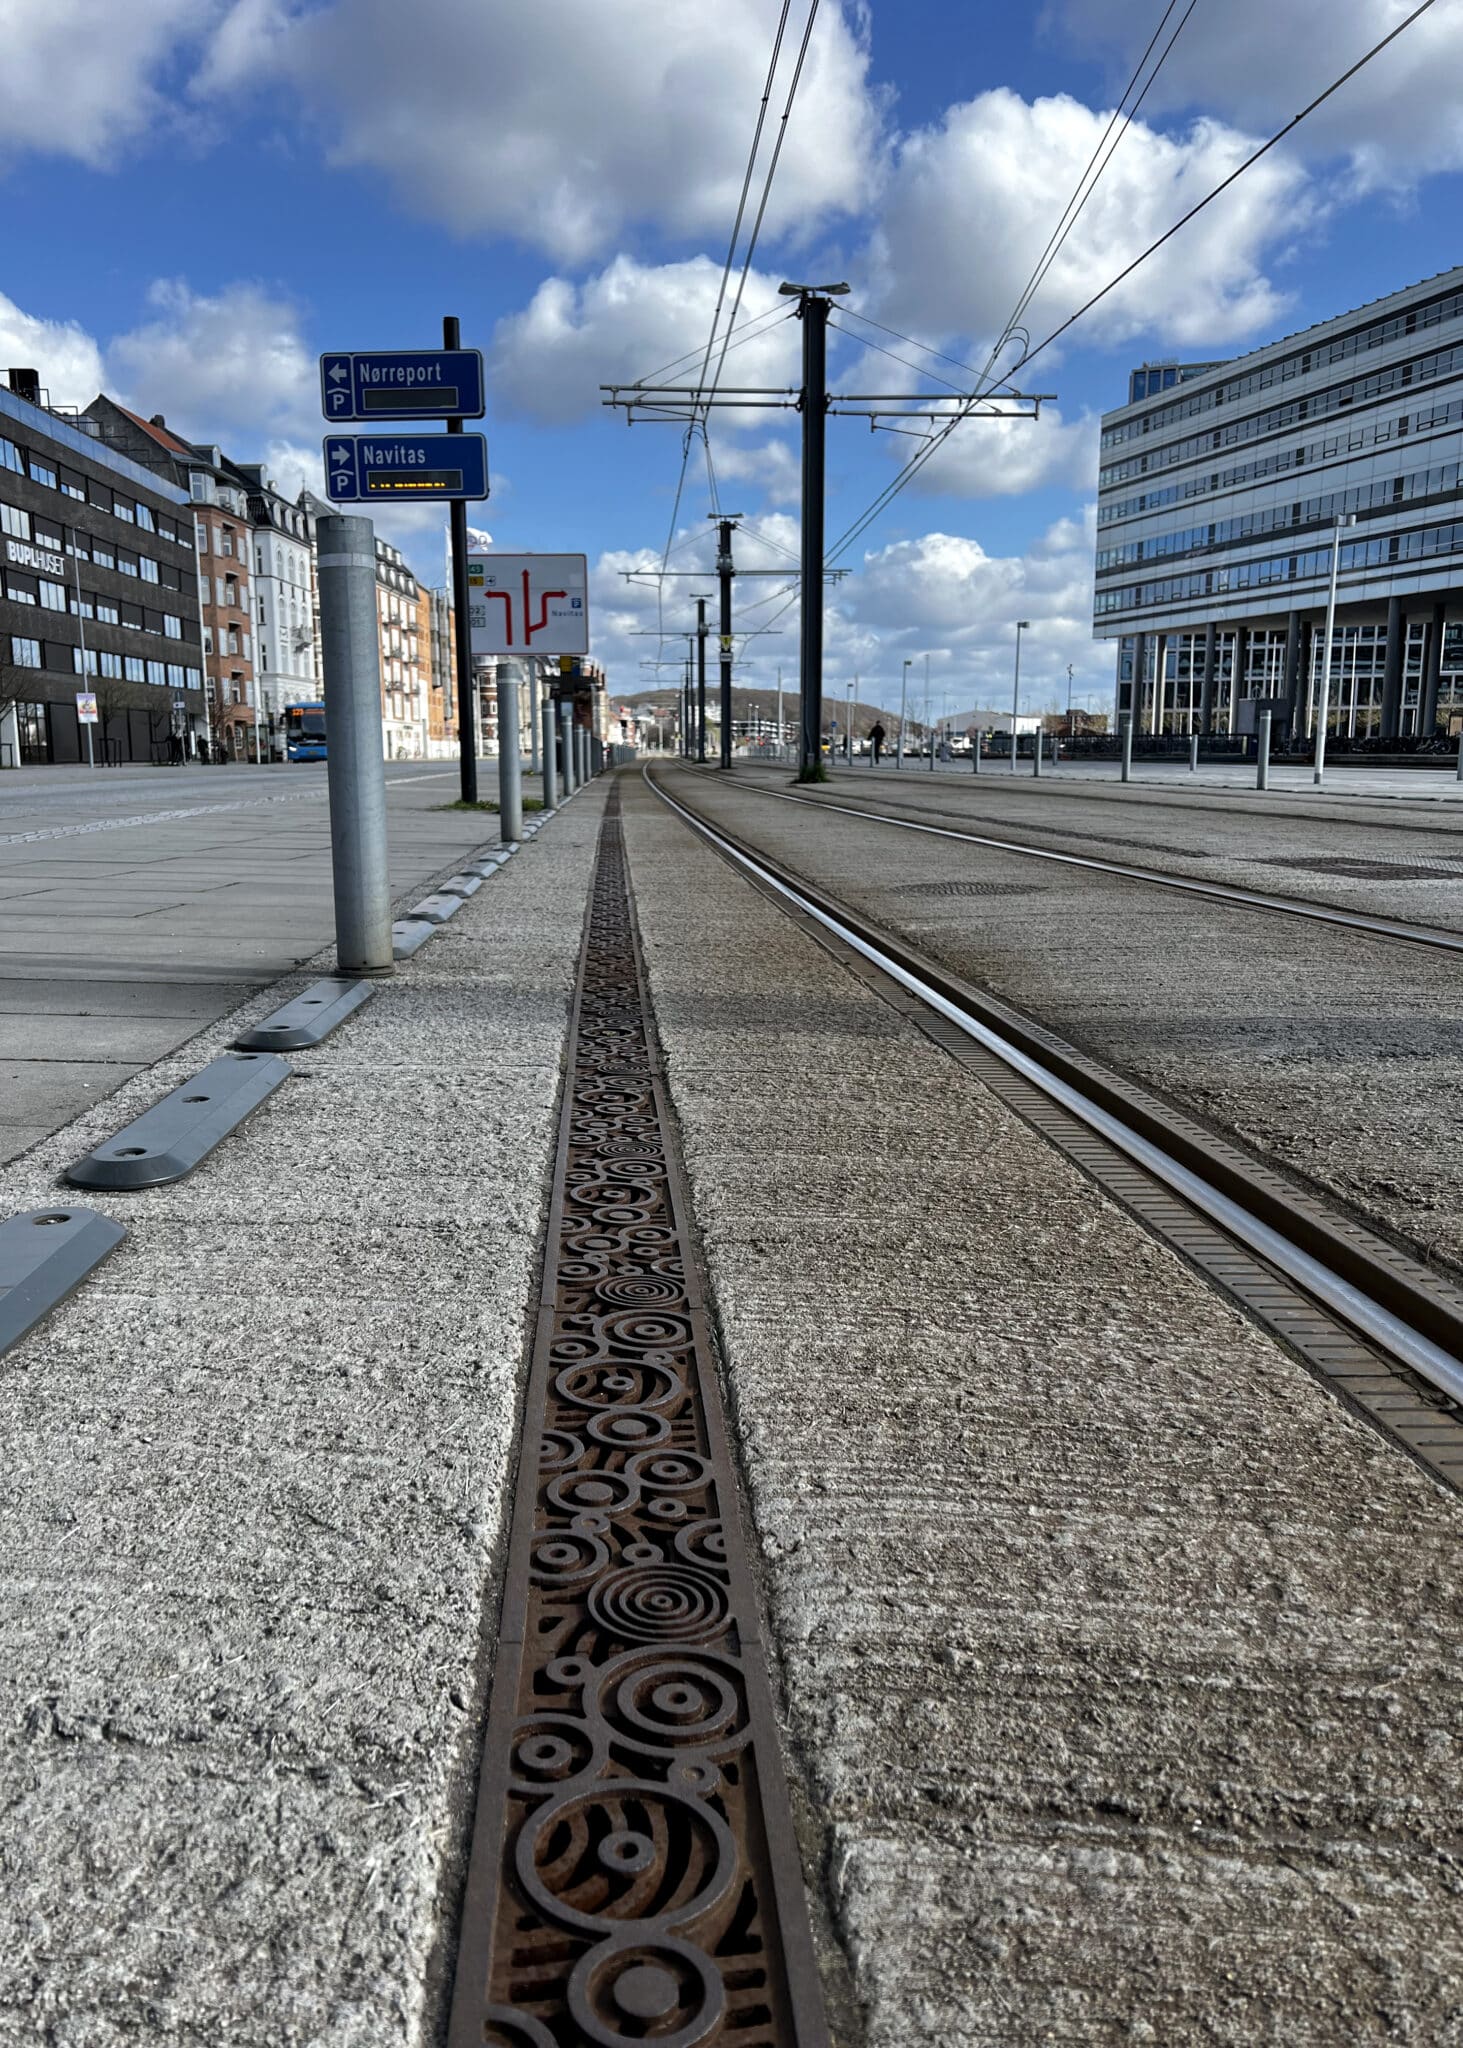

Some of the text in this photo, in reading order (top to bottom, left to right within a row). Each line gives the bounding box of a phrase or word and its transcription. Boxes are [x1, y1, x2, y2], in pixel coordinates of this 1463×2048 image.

[360, 363, 441, 386] Nørreport
[333, 394, 345, 411] P
[363, 445, 426, 465] Navitas
[337, 475, 349, 492] P
